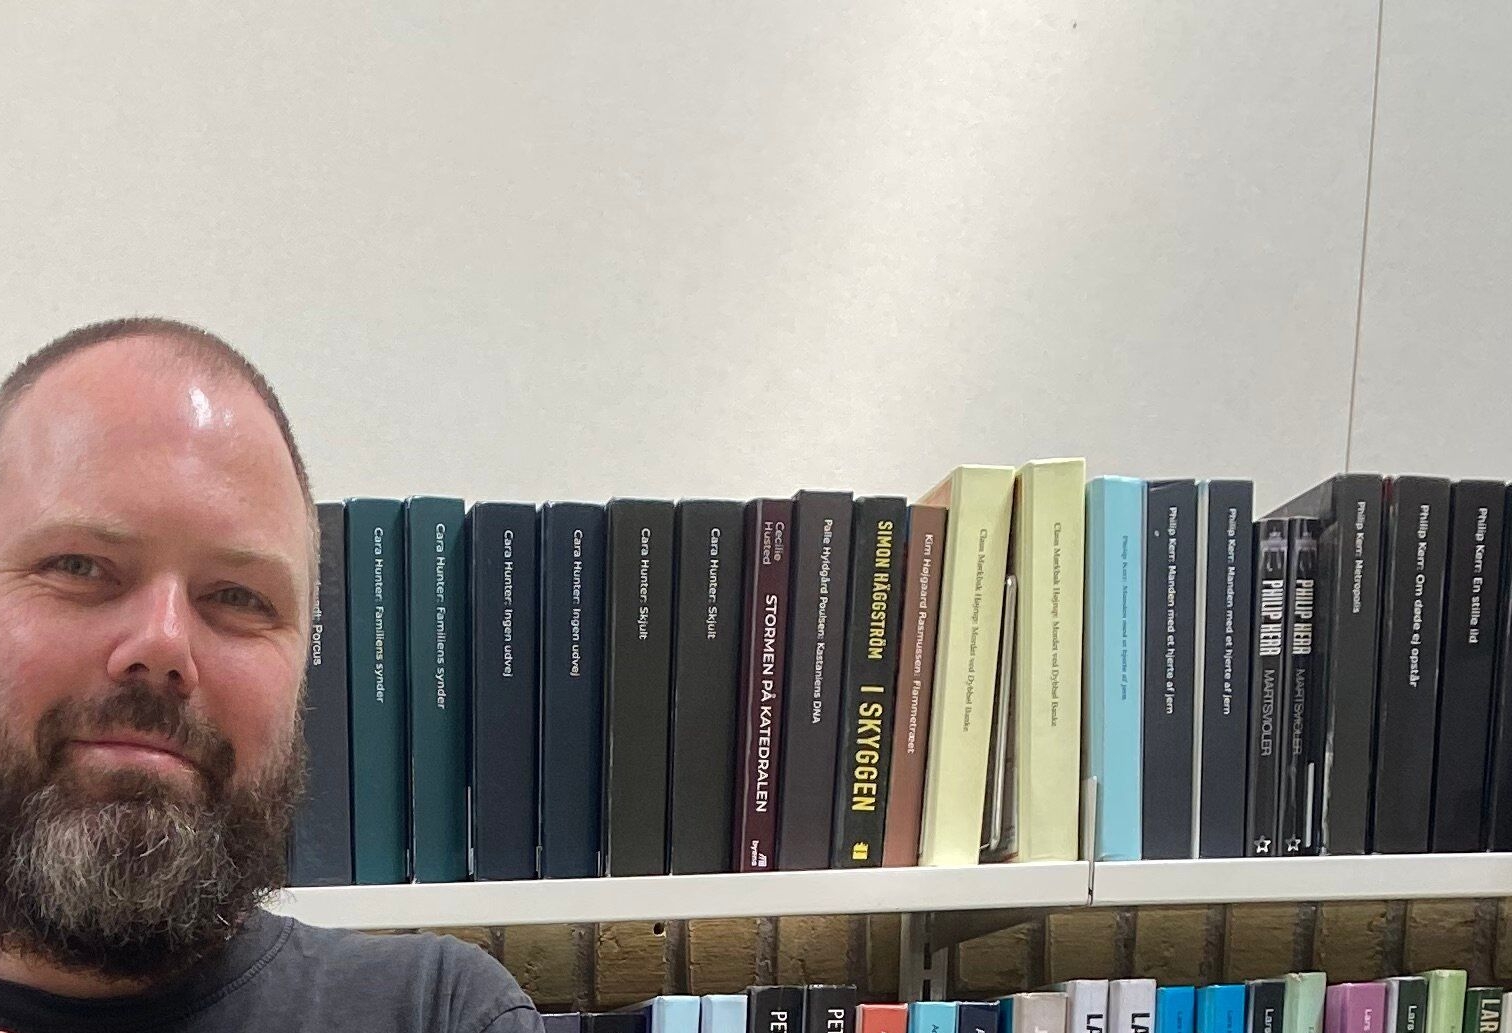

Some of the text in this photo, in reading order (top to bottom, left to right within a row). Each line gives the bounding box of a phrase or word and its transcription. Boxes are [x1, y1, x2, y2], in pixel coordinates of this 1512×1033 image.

[435, 523, 445, 554] Cara
[867, 520, 893, 660] SIMON HÄGGSTRÖM
[1260, 579, 1284, 620] PHILIP
[436, 606, 447, 664] Familiens
[436, 666, 446, 709] synder
[756, 595, 778, 813] STORMEN PÅ KATEDRALEN
[1260, 668, 1276, 757] MARTSVIOLER
[851, 684, 885, 812] I SKYGGEN
